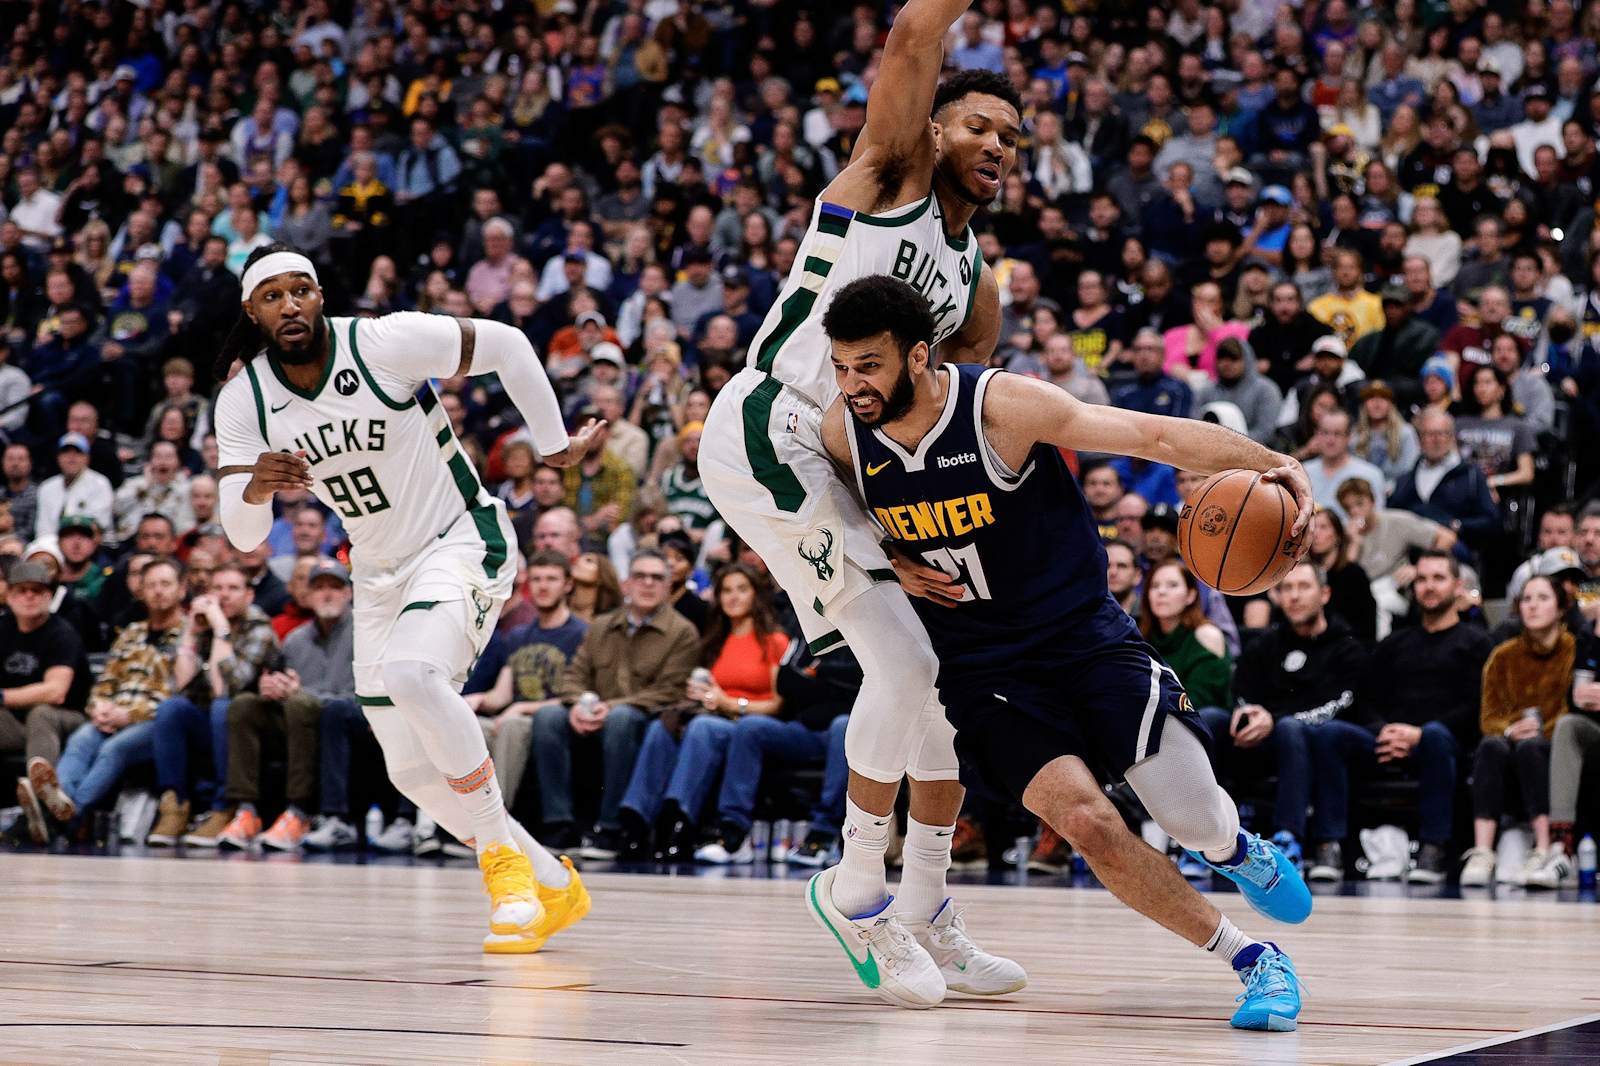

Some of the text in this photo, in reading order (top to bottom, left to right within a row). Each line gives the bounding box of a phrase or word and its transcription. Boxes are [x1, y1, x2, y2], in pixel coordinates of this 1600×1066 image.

[281, 419, 386, 466] UCKS
[937, 453, 977, 469] ibotta
[322, 466, 391, 518] 99
[874, 493, 995, 541] DENVER
[920, 542, 992, 602] 27
